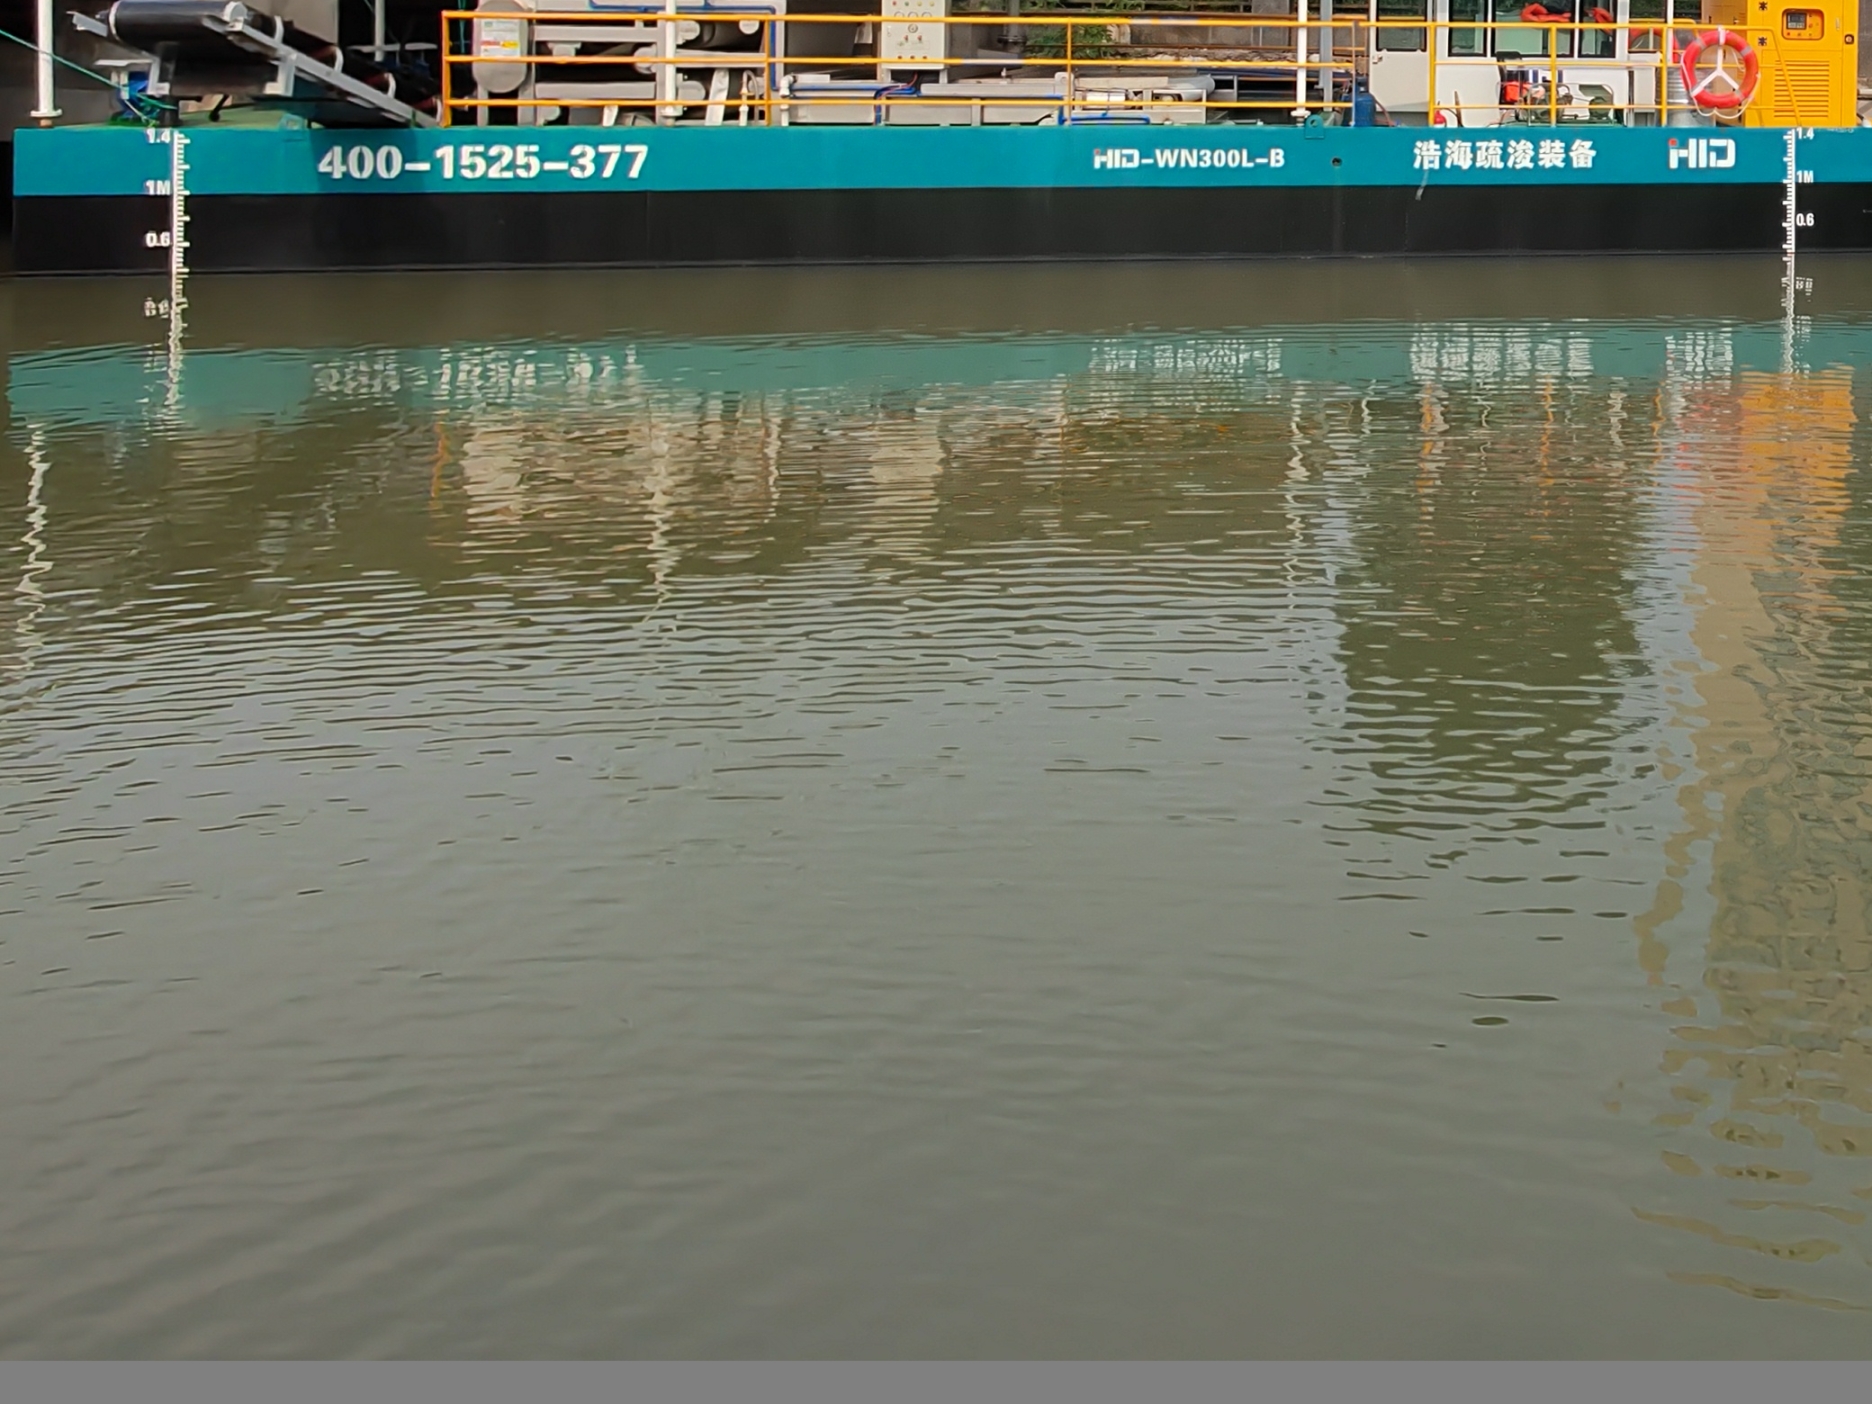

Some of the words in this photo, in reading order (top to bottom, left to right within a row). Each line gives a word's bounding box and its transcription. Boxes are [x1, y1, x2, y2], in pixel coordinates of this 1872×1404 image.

[146, 128, 171, 143] 1.4
[1796, 127, 1814, 140] 1.4
[317, 145, 649, 179] 400-1525-377
[1093, 148, 1285, 169] HID-WN300L-B
[1413, 139, 1597, 170] 浩海疏浚装备
[1796, 170, 1814, 184] 1M
[145, 180, 171, 195] 1M
[1796, 213, 1815, 227] 0.6
[145, 231, 171, 247] 0.6
